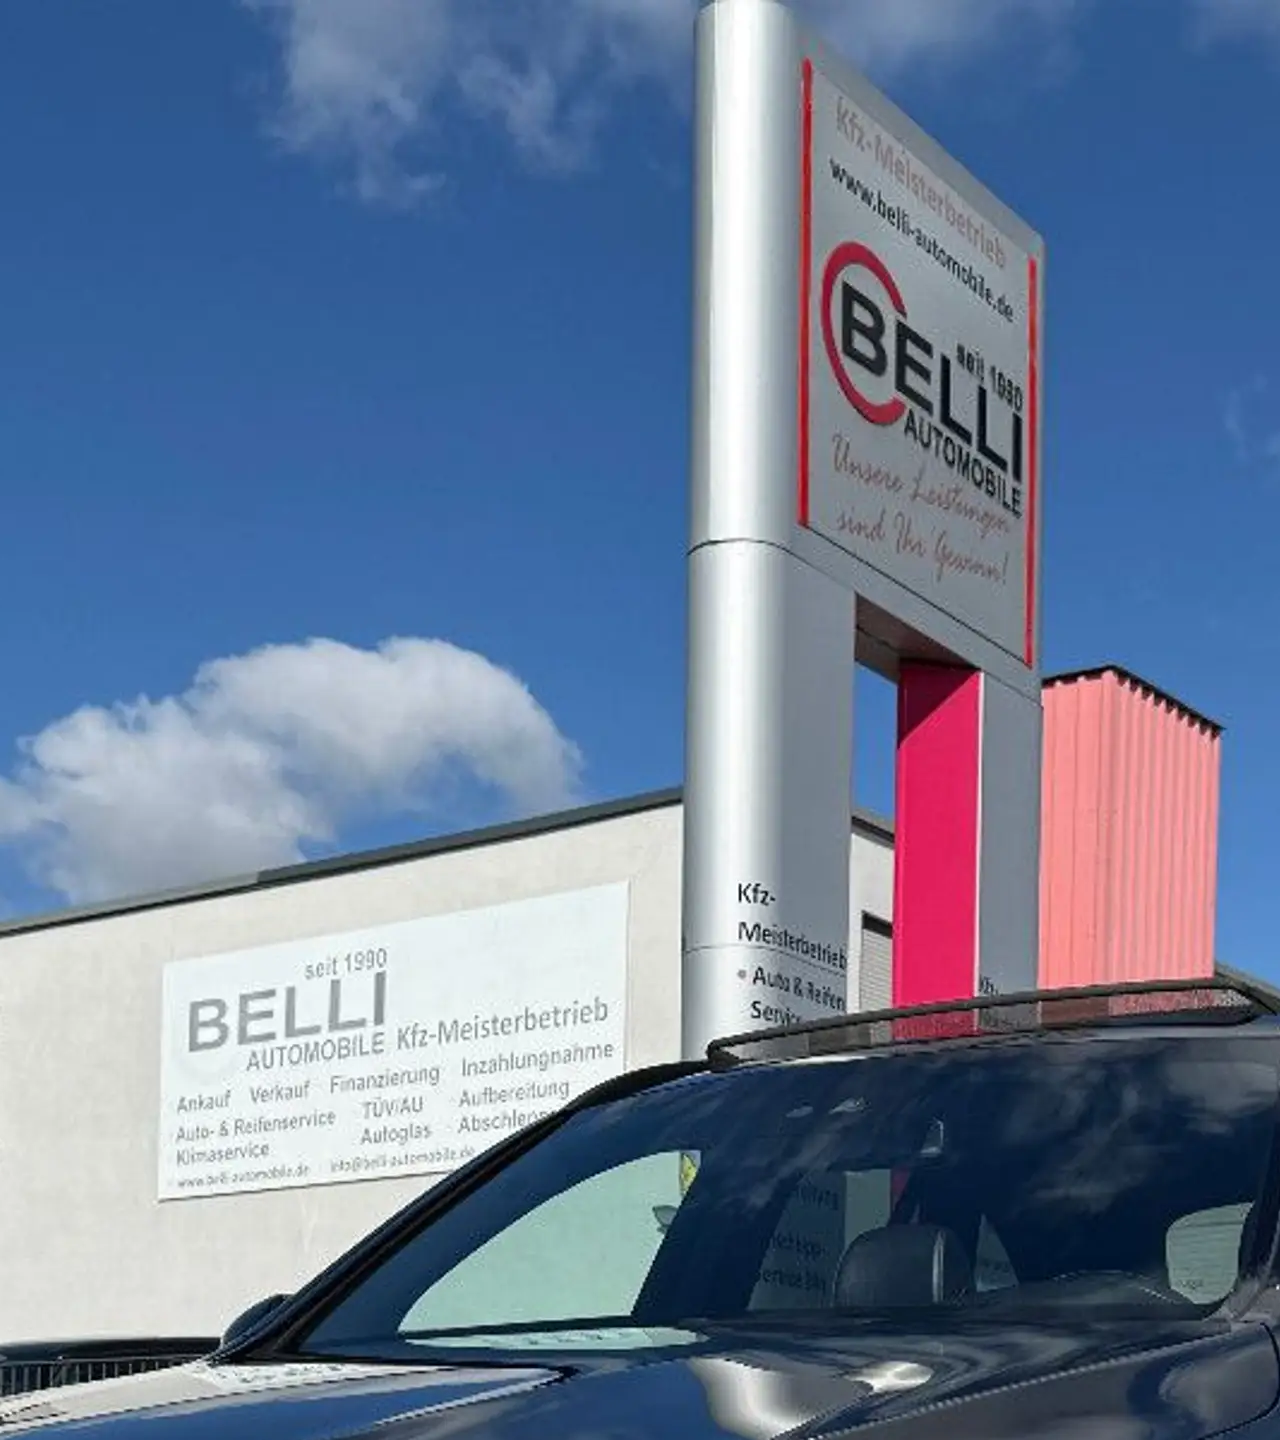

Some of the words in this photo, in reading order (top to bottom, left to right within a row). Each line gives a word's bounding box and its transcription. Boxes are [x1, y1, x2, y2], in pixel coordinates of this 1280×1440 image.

[829, 158, 1015, 322] www.belli-automobile.de
[841, 280, 1023, 482] BELLI
[904, 408, 1023, 519] AUTOMOBILE
[737, 883, 776, 906] Kfz-
[305, 956, 338, 980] seit
[344, 947, 388, 973] 1990
[737, 921, 848, 971] Meisterbetrieb
[188, 970, 387, 1052] BELLI
[752, 966, 790, 993] Auto
[246, 1031, 385, 1072] AUTOMOBILE
[397, 996, 609, 1051] Kfz-Meisterbetrieb
[176, 1089, 232, 1114] Ankauf
[250, 1079, 311, 1104] Verkauf
[330, 1066, 441, 1094] Finanzierung
[461, 1042, 615, 1078] Inzahlungnahme
[234, 1109, 337, 1136] Reifenservice
[458, 1081, 570, 1107] Aufbereitung
[176, 1142, 270, 1167] Klimaservice
[360, 1123, 433, 1146] Autoglas
